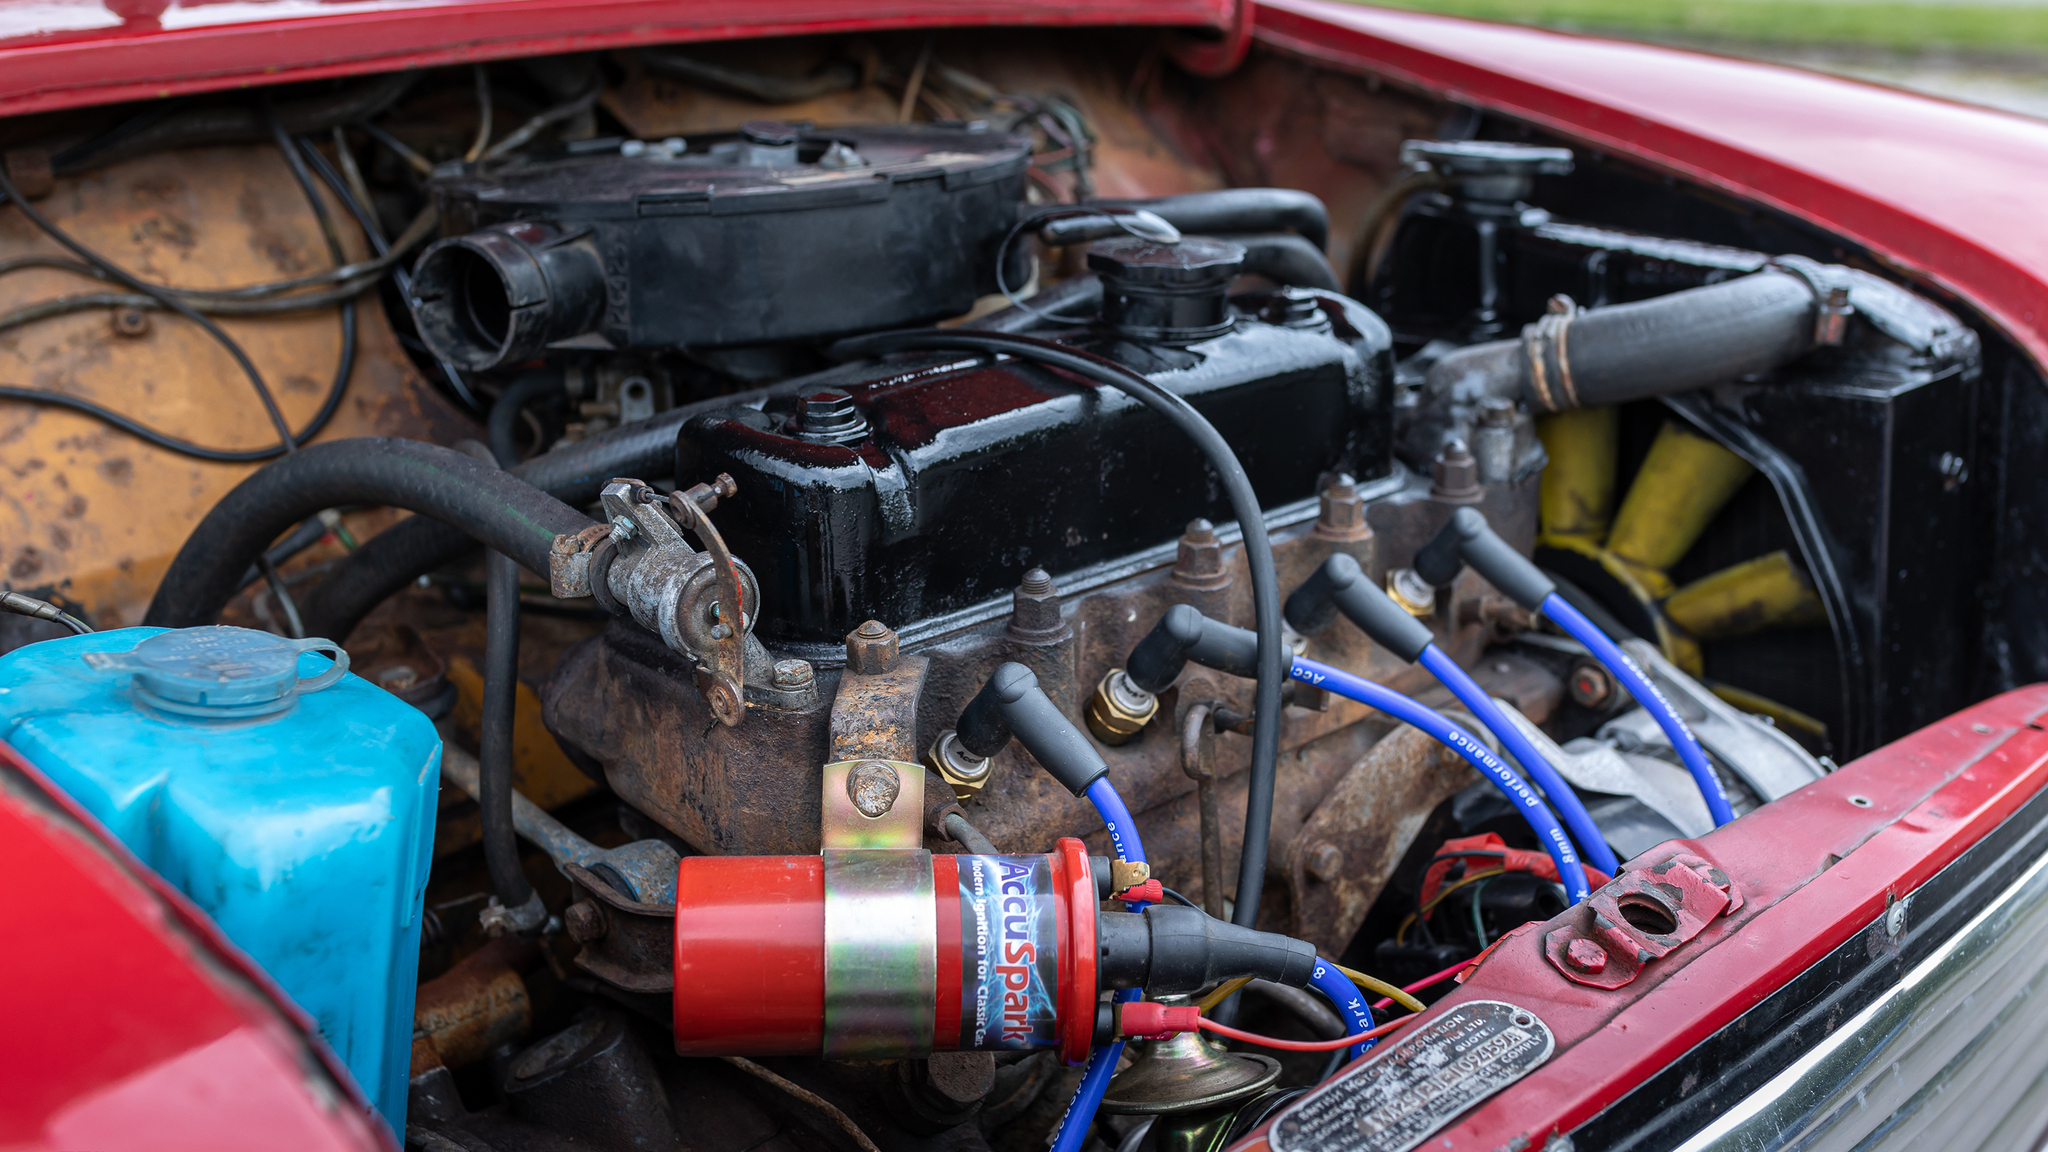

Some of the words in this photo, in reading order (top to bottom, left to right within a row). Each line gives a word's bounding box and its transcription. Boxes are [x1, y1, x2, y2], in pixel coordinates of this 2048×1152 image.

[1448, 731, 1540, 807] performance
[1549, 828, 1575, 864] 8mm
[972, 860, 985, 895] Modern
[973, 899, 988, 955] Ignition
[977, 958, 989, 981] for
[996, 861, 1036, 1042] AccuSpark
[976, 987, 989, 1026] Classic
[1500, 1033, 1543, 1064] COMPLY
